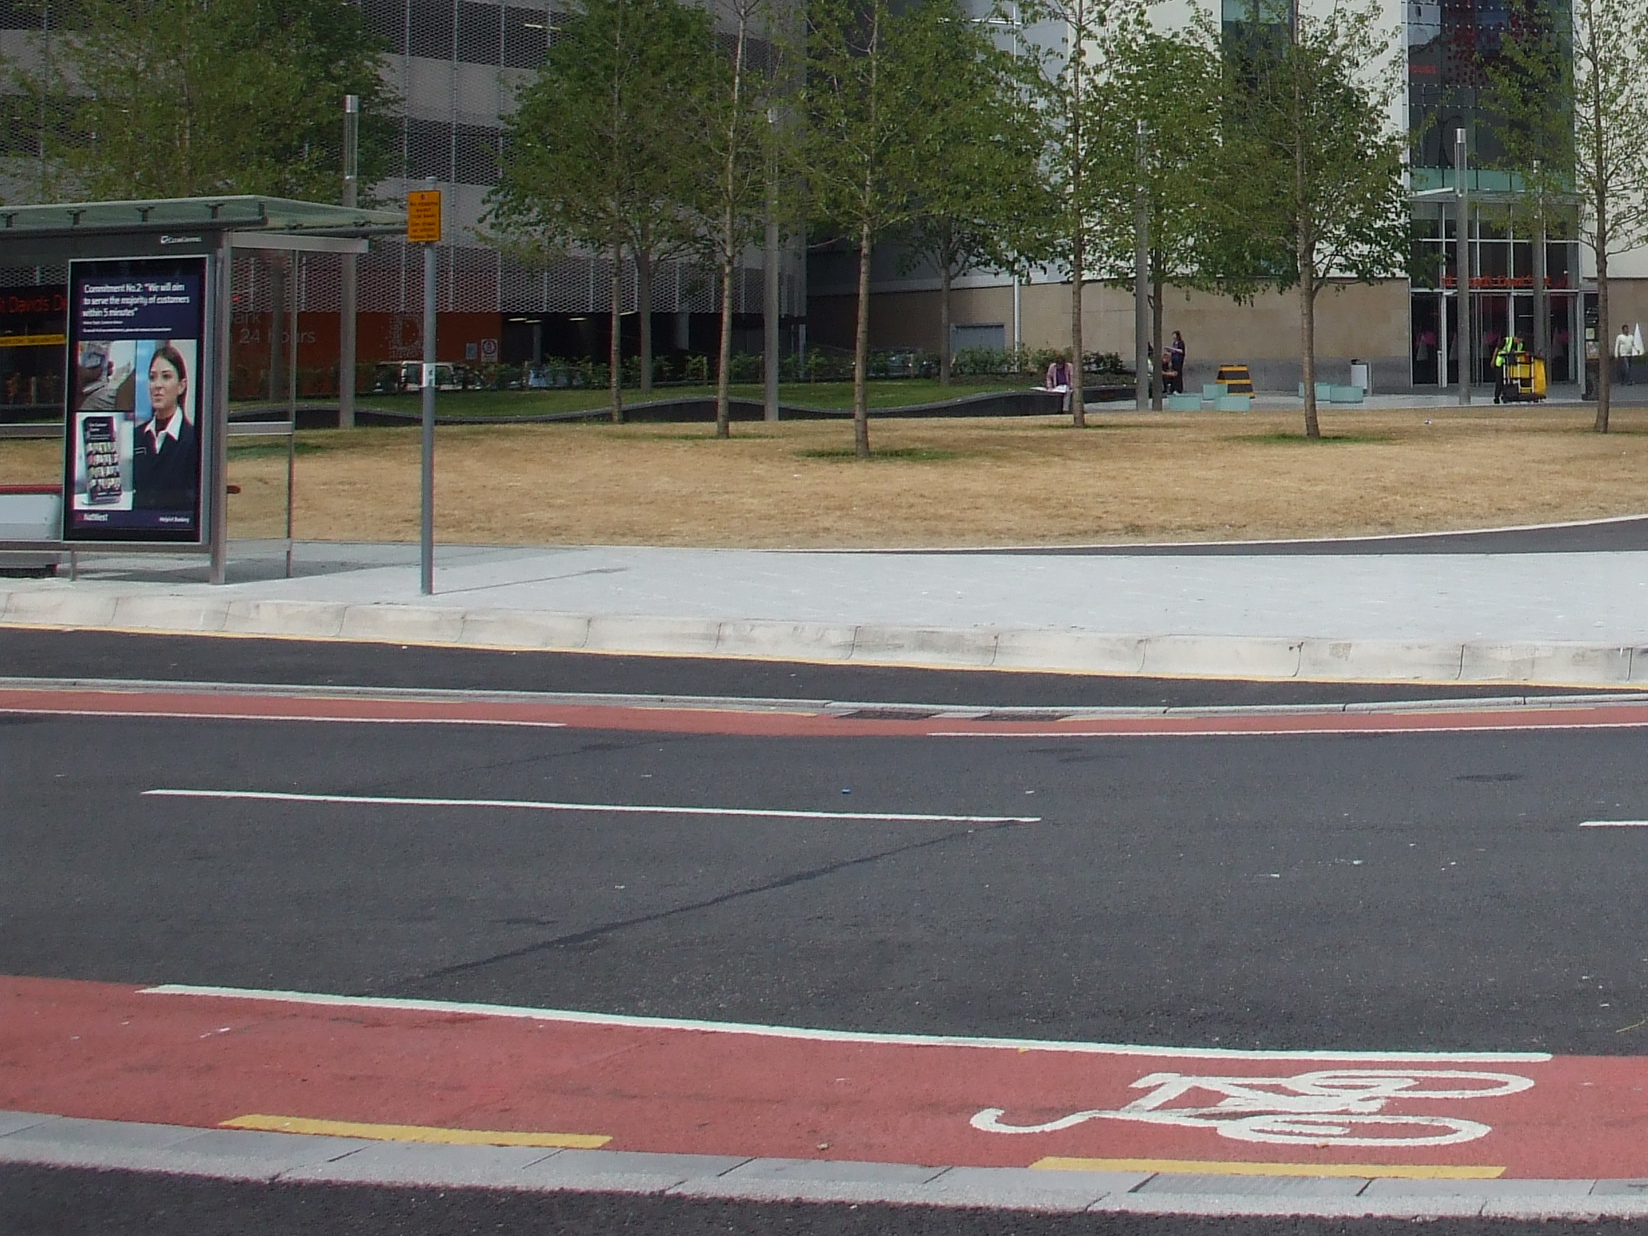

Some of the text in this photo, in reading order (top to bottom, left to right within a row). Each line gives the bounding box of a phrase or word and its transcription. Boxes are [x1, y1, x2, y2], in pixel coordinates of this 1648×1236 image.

[84, 284, 126, 294] Commitment
[172, 282, 185, 292] aim
[83, 295, 190, 307] to serve the majority of customers
[82, 308, 103, 317] within
[103, 308, 109, 317] 5
[239, 328, 261, 344] 24
